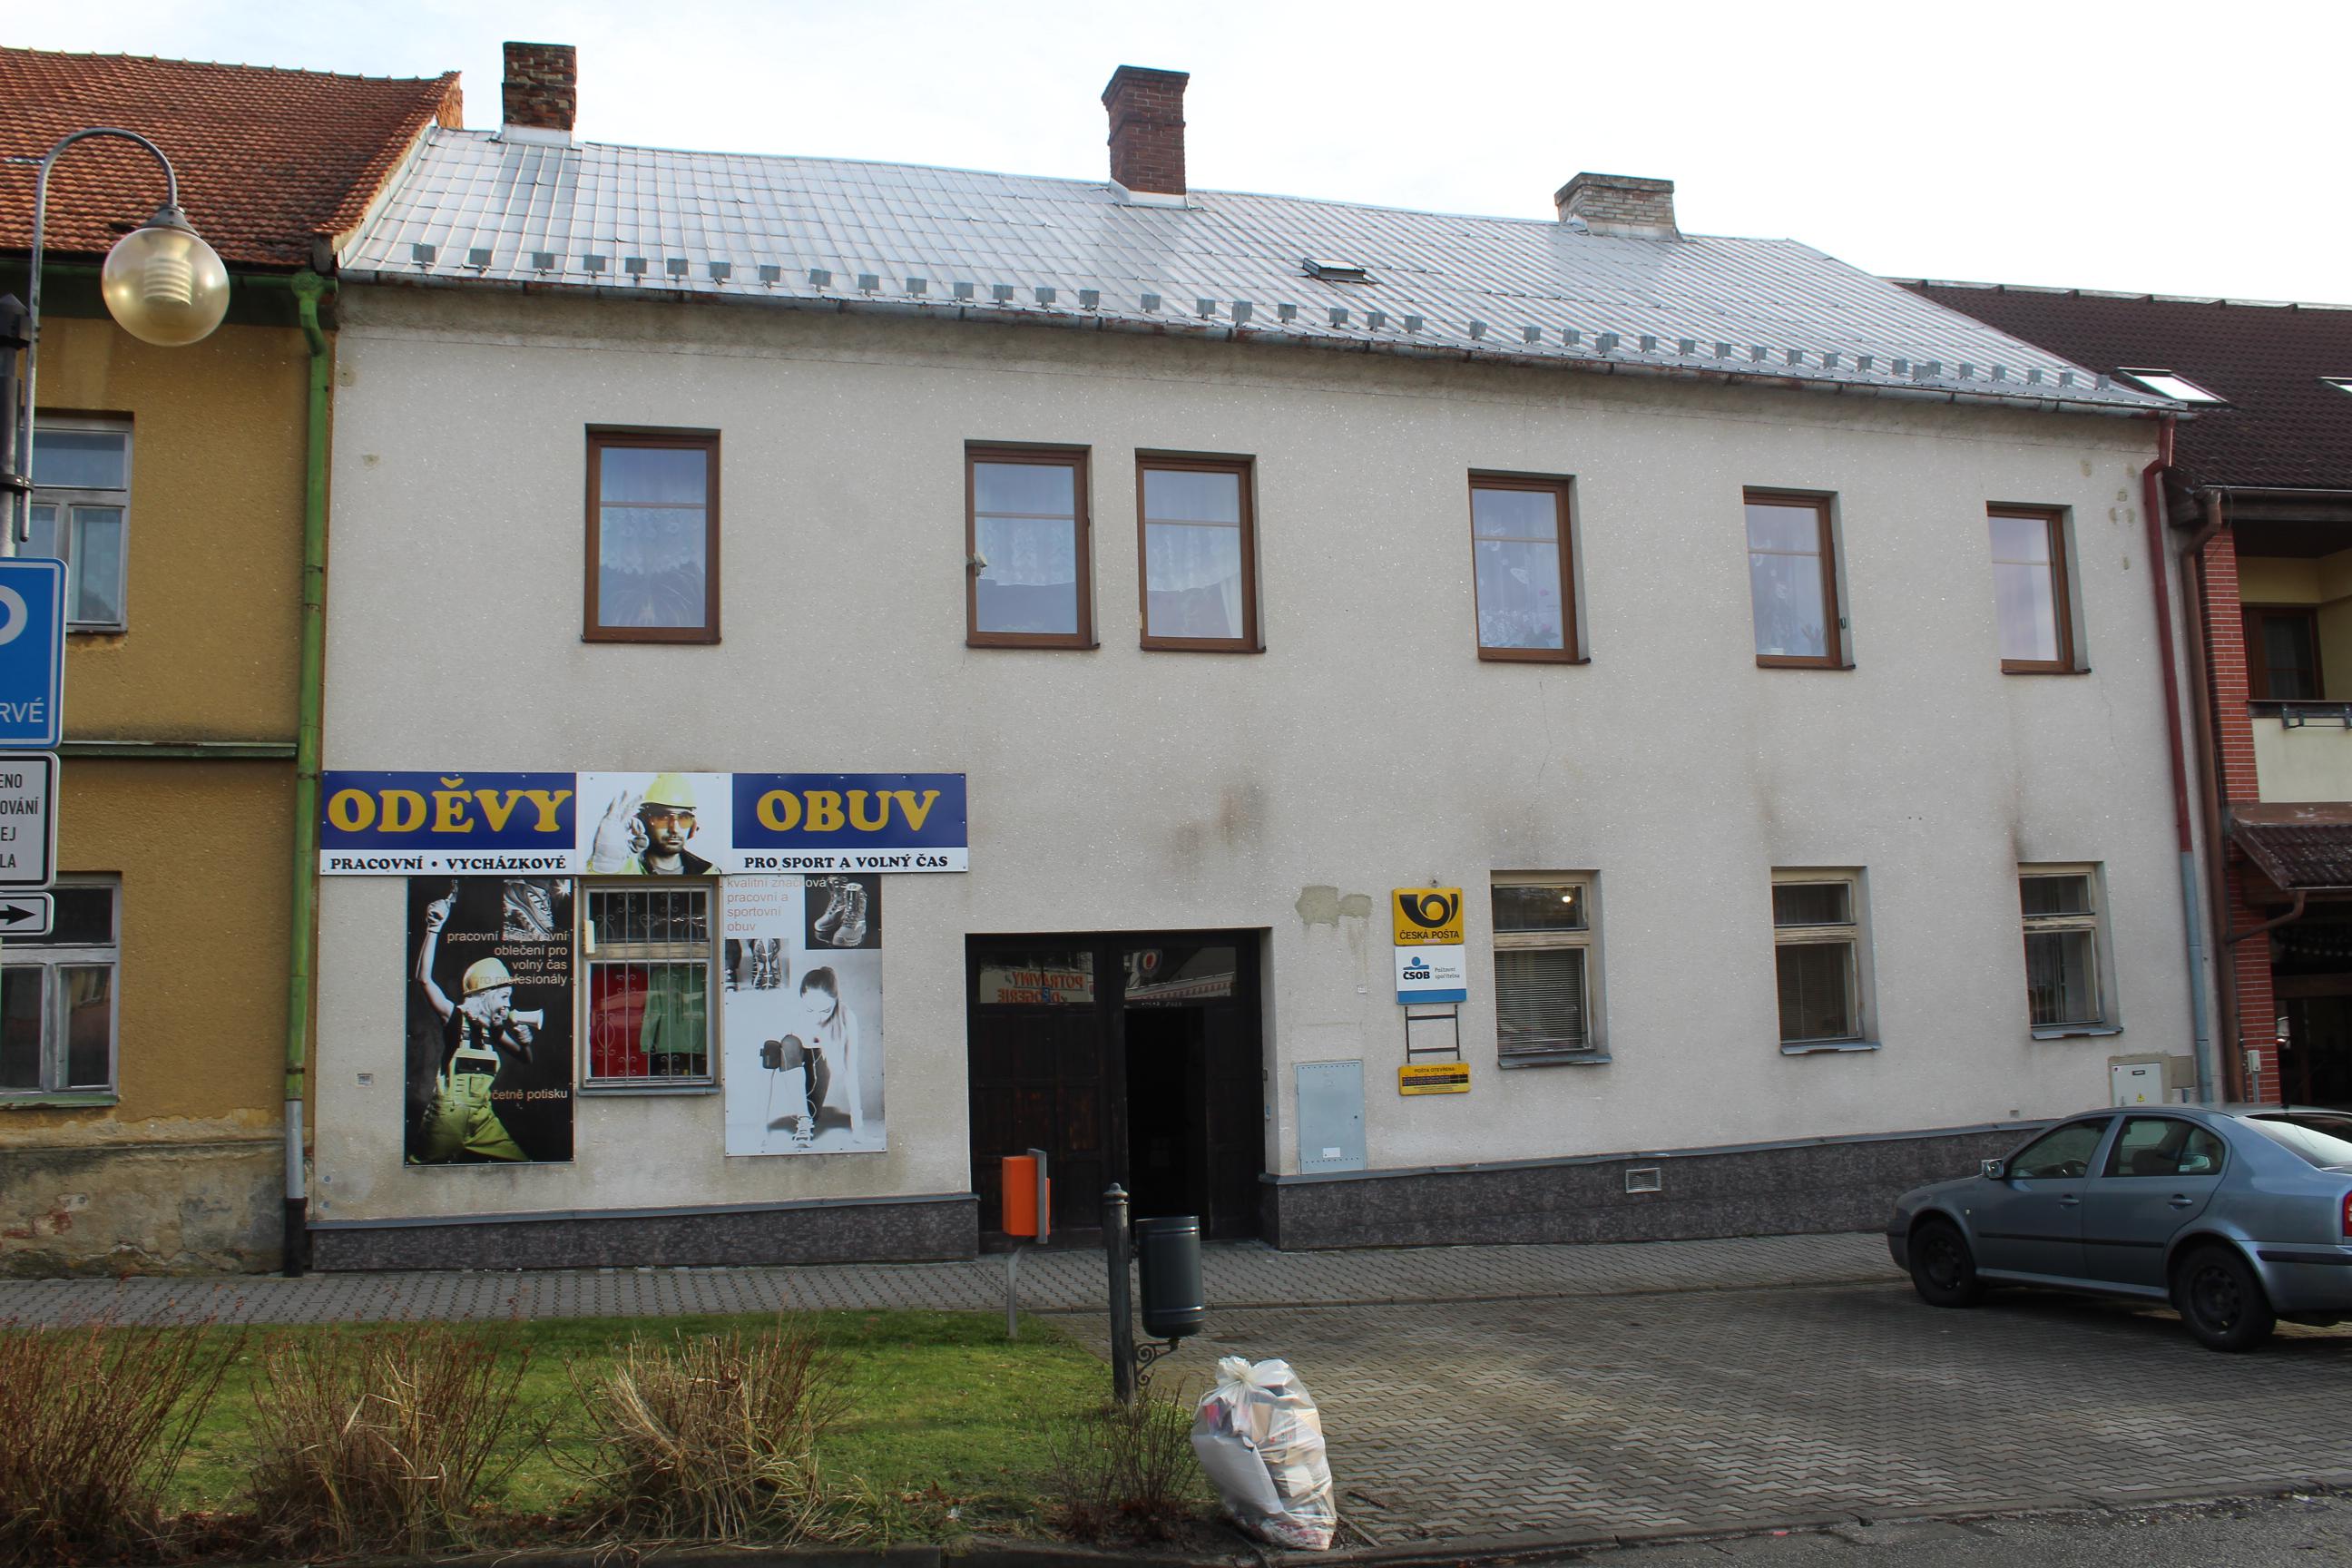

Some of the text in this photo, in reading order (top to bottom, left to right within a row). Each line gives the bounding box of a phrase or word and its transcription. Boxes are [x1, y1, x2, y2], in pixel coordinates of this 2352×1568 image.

[328, 777, 573, 833] ODĚVY
[756, 789, 941, 833] OBUV
[330, 855, 566, 869] PRACOVNÍ VYCHÁZKOVÉ
[744, 854, 948, 868] PRO SPORT A VOLNÝ ČAS
[727, 877, 828, 888] kvalitní značová
[727, 893, 789, 905] pracovní a
[727, 906, 781, 919] sportovní
[727, 921, 756, 931] obuv
[447, 930, 499, 944] pracovní
[1399, 928, 1460, 940] ČESKÁ POŠTA
[495, 946, 568, 957] oblečení pro
[512, 959, 568, 972] volný čas
[1403, 971, 1430, 980] ČSOB
[491, 1089, 568, 1102] četně potisku
